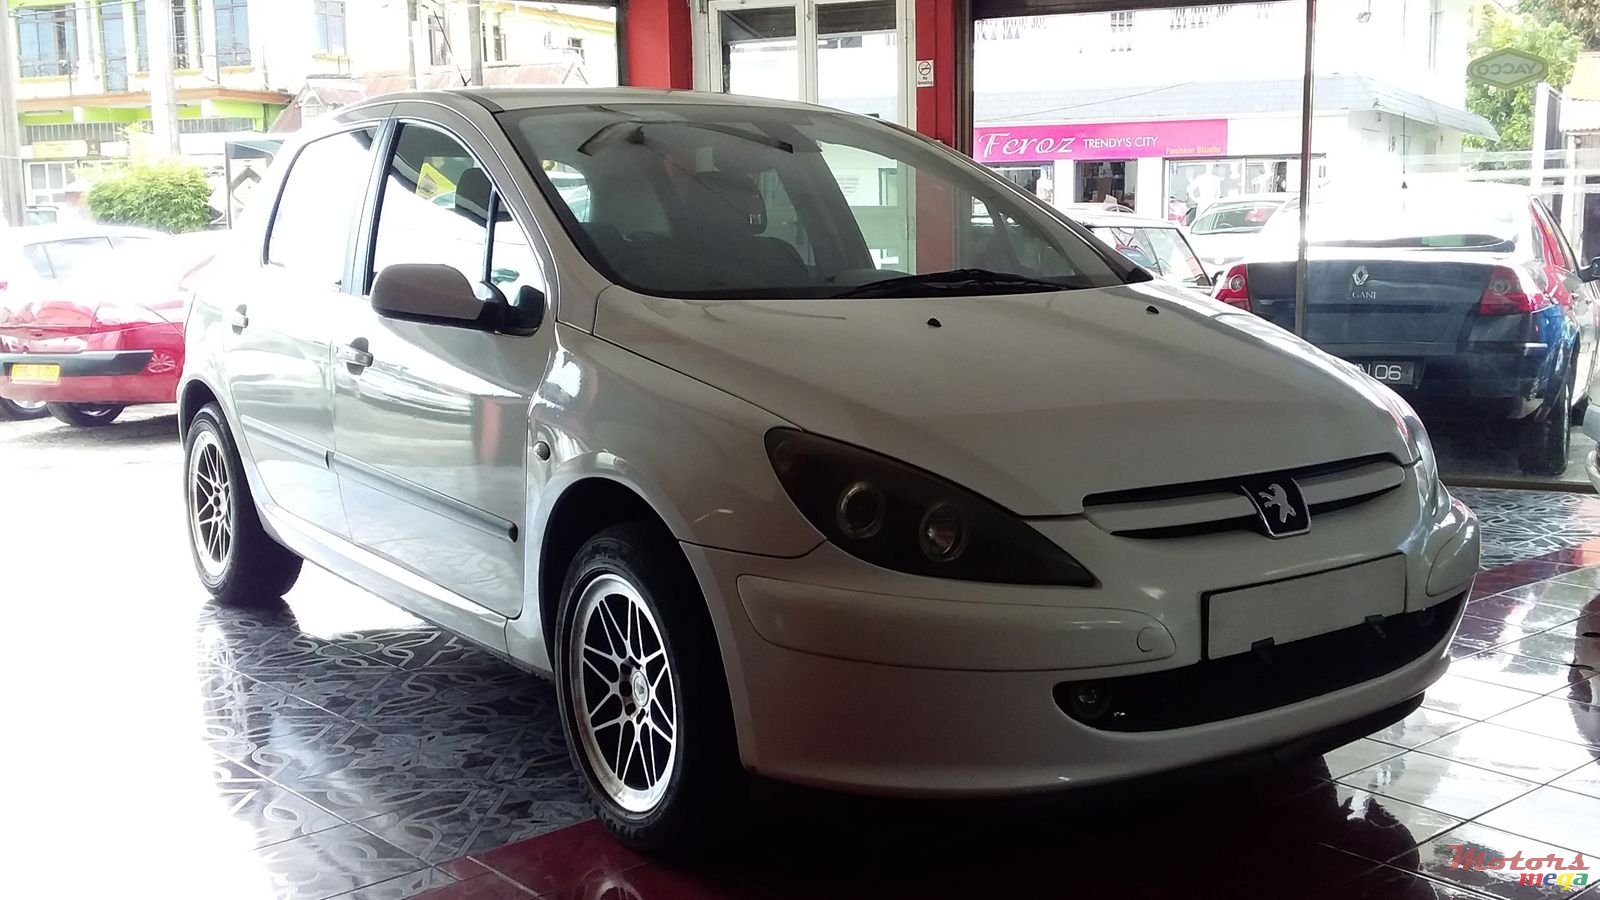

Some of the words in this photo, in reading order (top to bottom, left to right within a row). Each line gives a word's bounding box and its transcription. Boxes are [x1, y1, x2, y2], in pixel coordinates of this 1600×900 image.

[978, 132, 1076, 158] Feroz
[1083, 137, 1132, 149] TRENDY'S
[1134, 136, 1158, 148] CITY
[1165, 147, 1195, 155] Fashion
[1196, 146, 1222, 154] Studio
[1375, 364, 1401, 380] 06
